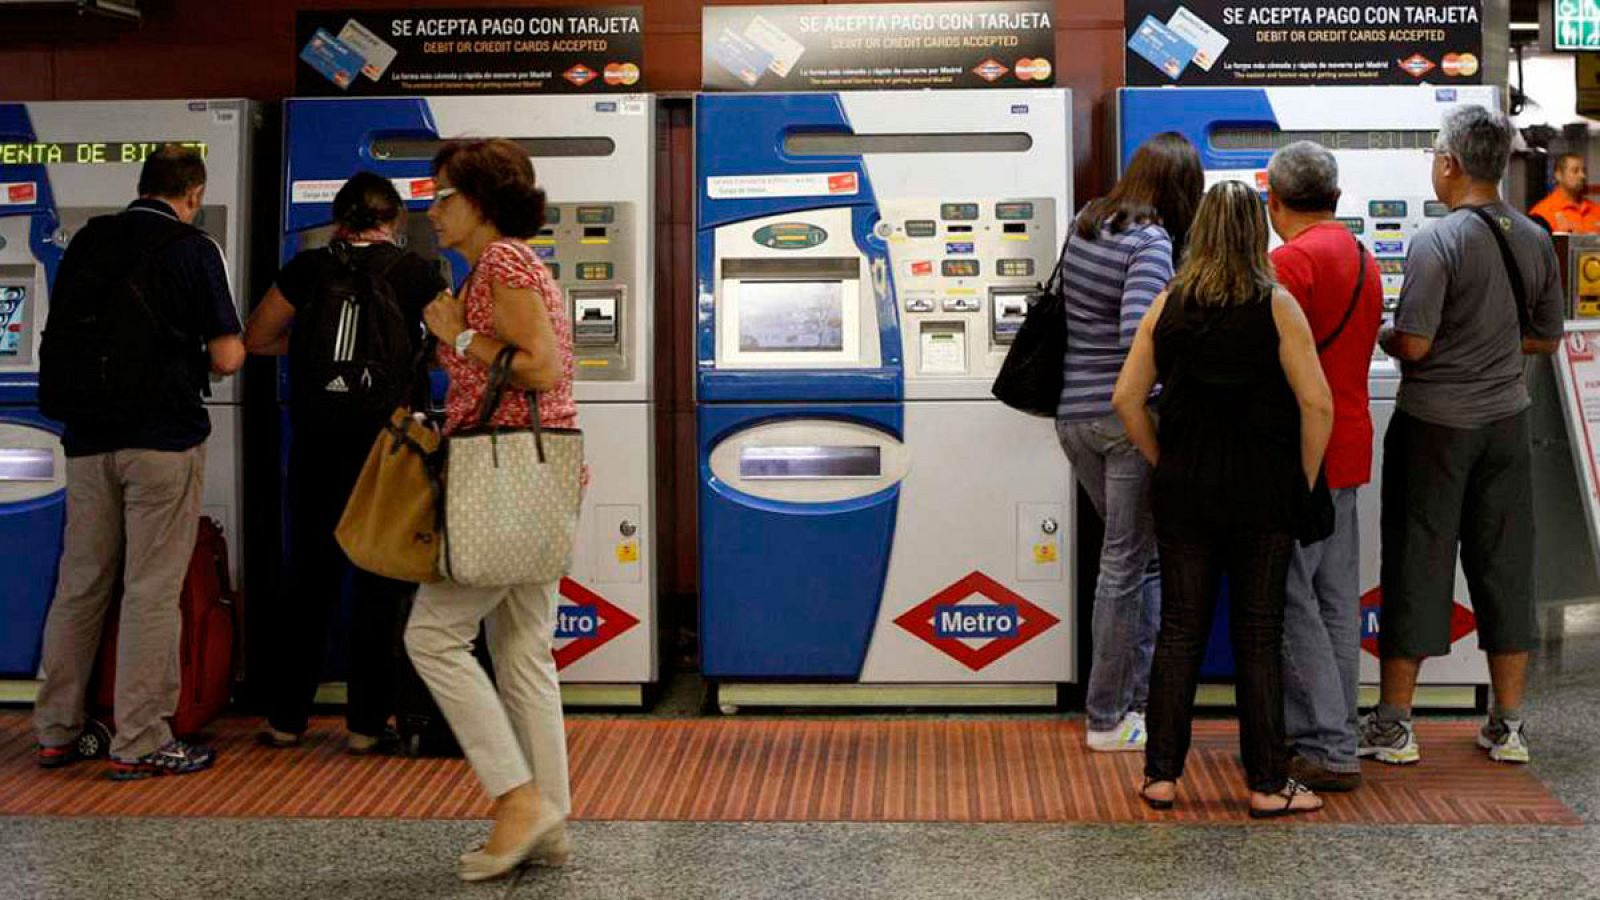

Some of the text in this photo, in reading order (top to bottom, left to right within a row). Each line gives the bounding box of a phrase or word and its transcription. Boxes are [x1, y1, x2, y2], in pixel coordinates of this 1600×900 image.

[800, 12, 1051, 32] SE ACEPTA PAGO CON TARJETA
[1223, 6, 1478, 24] SE ACEPTA PAGO CON TARJETA
[391, 17, 640, 36] SE ACEPTA PAGO CON TARJETA
[1256, 30, 1445, 42] DEBIT OR CREDIT CARDS ACCEPTED
[424, 40, 608, 53] DEBIT OR CREDIT CARDS ACCEPTED
[831, 36, 1018, 49] DEBIT OR CREDIT CARDS ACCEPTED
[0, 144, 61, 164] ENTA
[77, 144, 106, 163] DE
[559, 613, 593, 632] tro
[941, 611, 1012, 633] Metro
